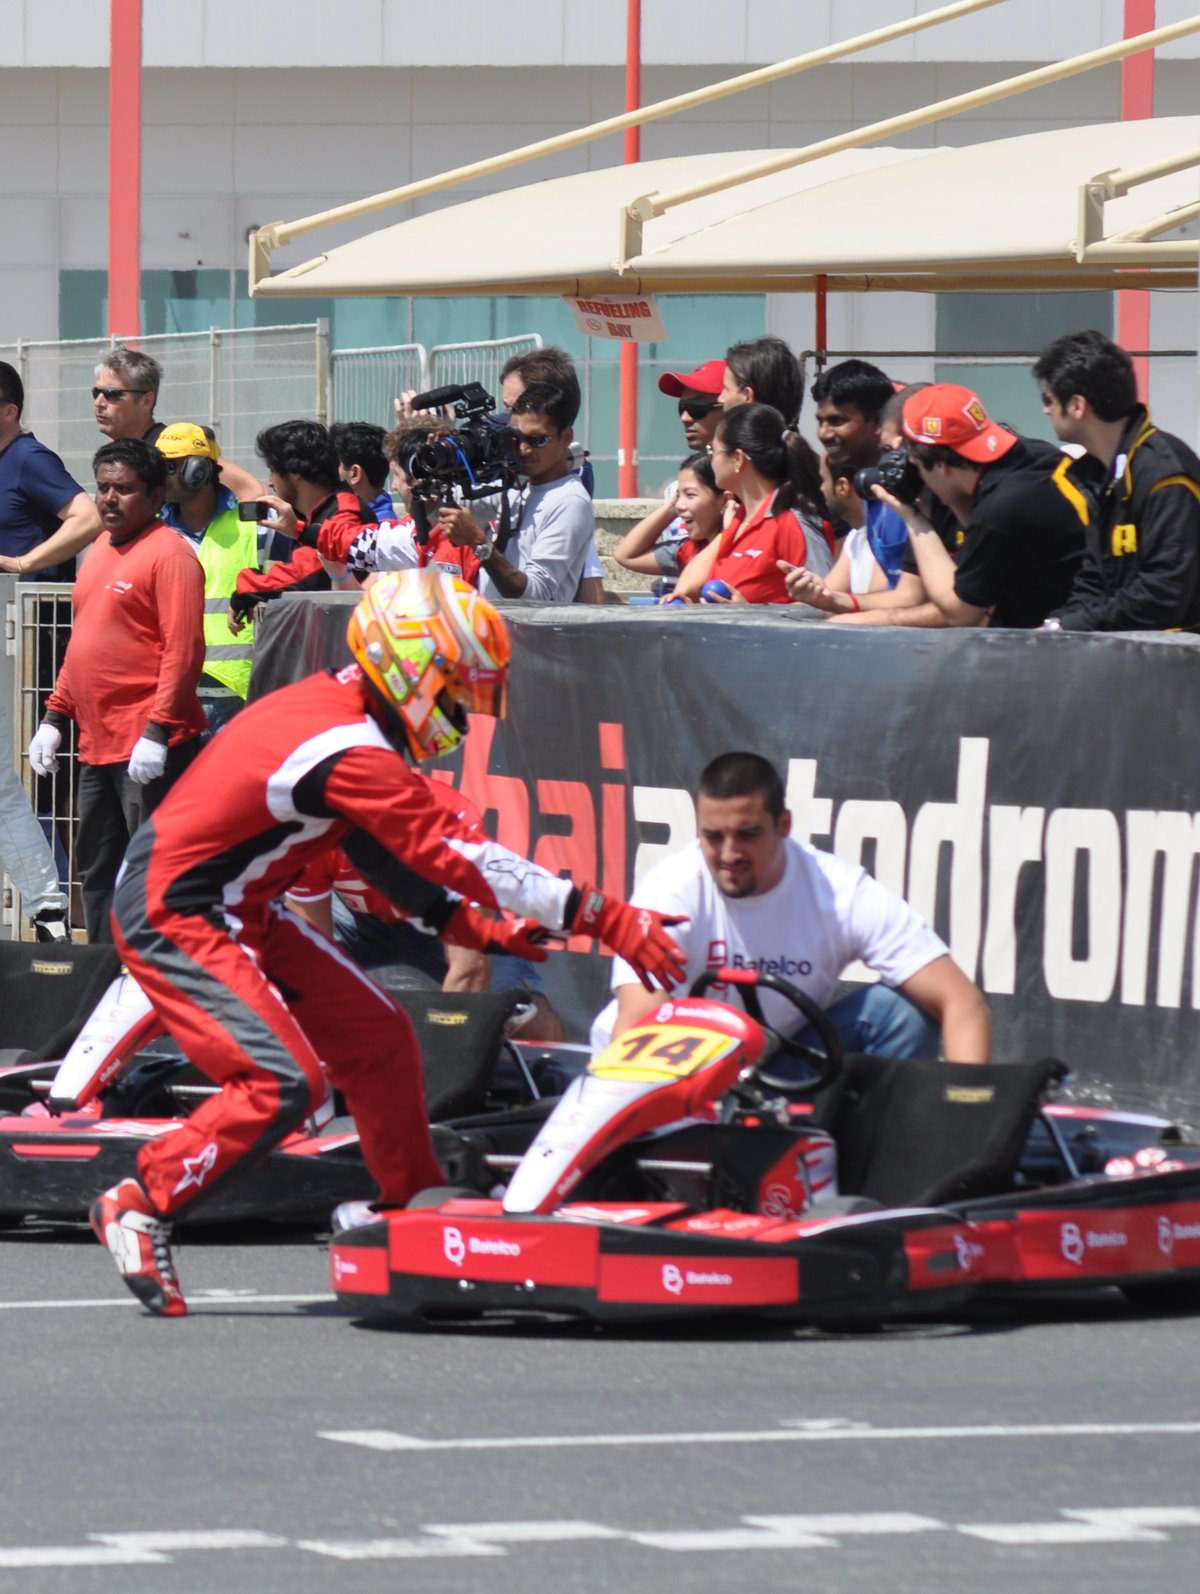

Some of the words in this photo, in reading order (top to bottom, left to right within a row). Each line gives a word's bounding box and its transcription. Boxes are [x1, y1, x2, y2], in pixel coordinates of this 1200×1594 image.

[575, 299, 652, 319] REFUELING
[606, 321, 633, 338] BAY
[412, 712, 627, 957] bai
[633, 737, 1200, 1010] atodrom
[733, 954, 813, 976] Batelco
[622, 1032, 707, 1066] 14
